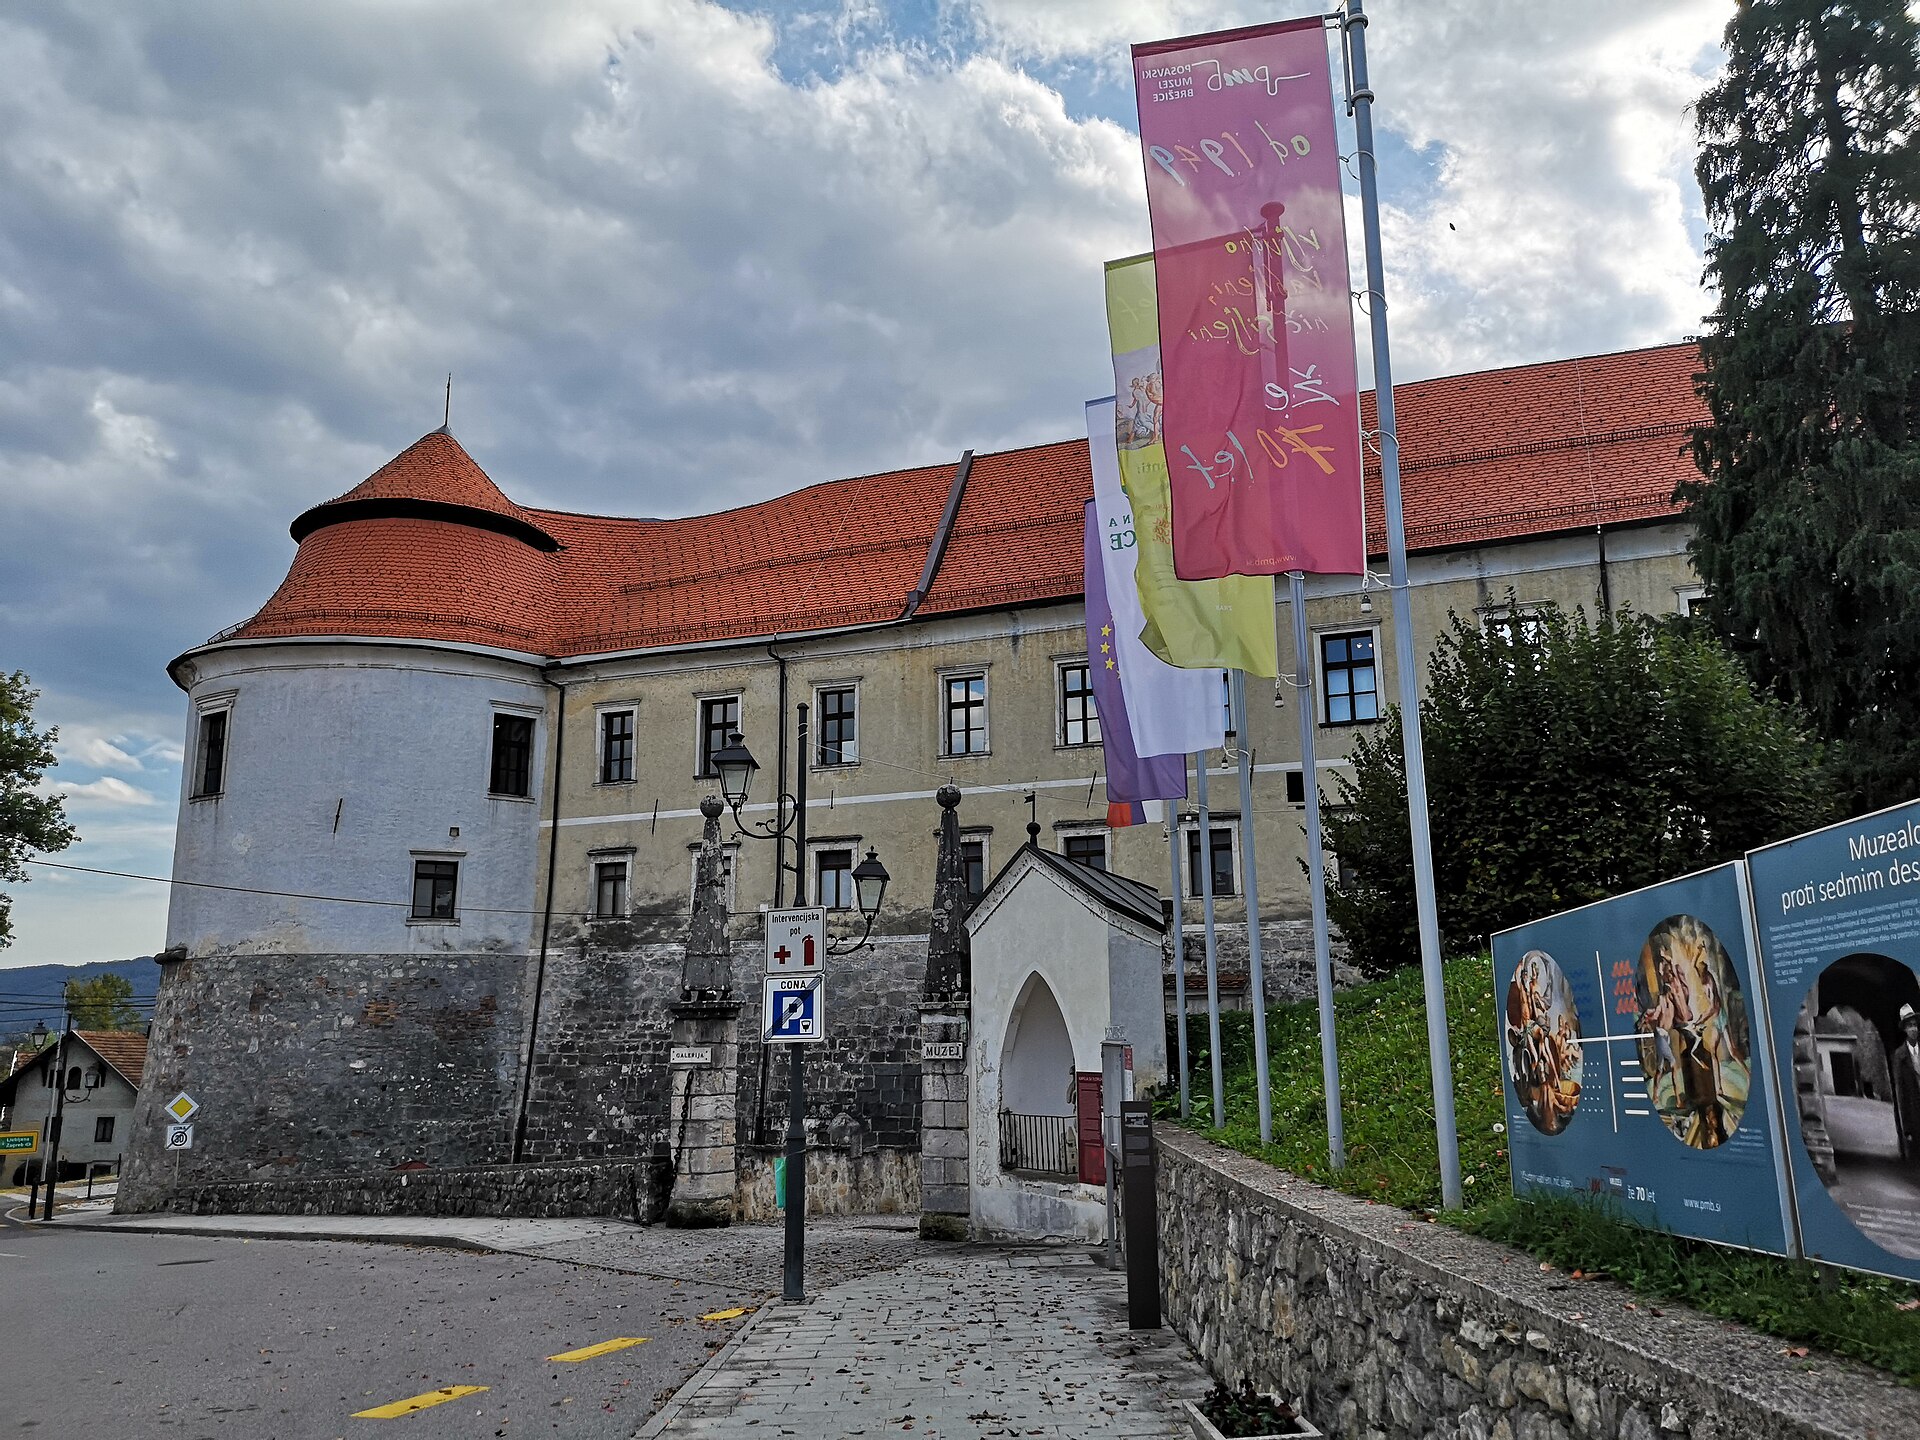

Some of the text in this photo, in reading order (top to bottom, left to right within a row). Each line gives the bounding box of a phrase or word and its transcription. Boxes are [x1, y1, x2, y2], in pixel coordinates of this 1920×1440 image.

[1781, 880, 1816, 916] proti
[1819, 867, 1884, 901] sedmim
[772, 912, 820, 923] Intervencijska
[789, 926, 801, 937] pot
[780, 980, 806, 990] CONA
[926, 1046, 960, 1056] MUZEJ
[174, 1134, 185, 1143] 30
[1635, 1186, 1645, 1201] 70
[1683, 1198, 1721, 1213] www.pmb.si
